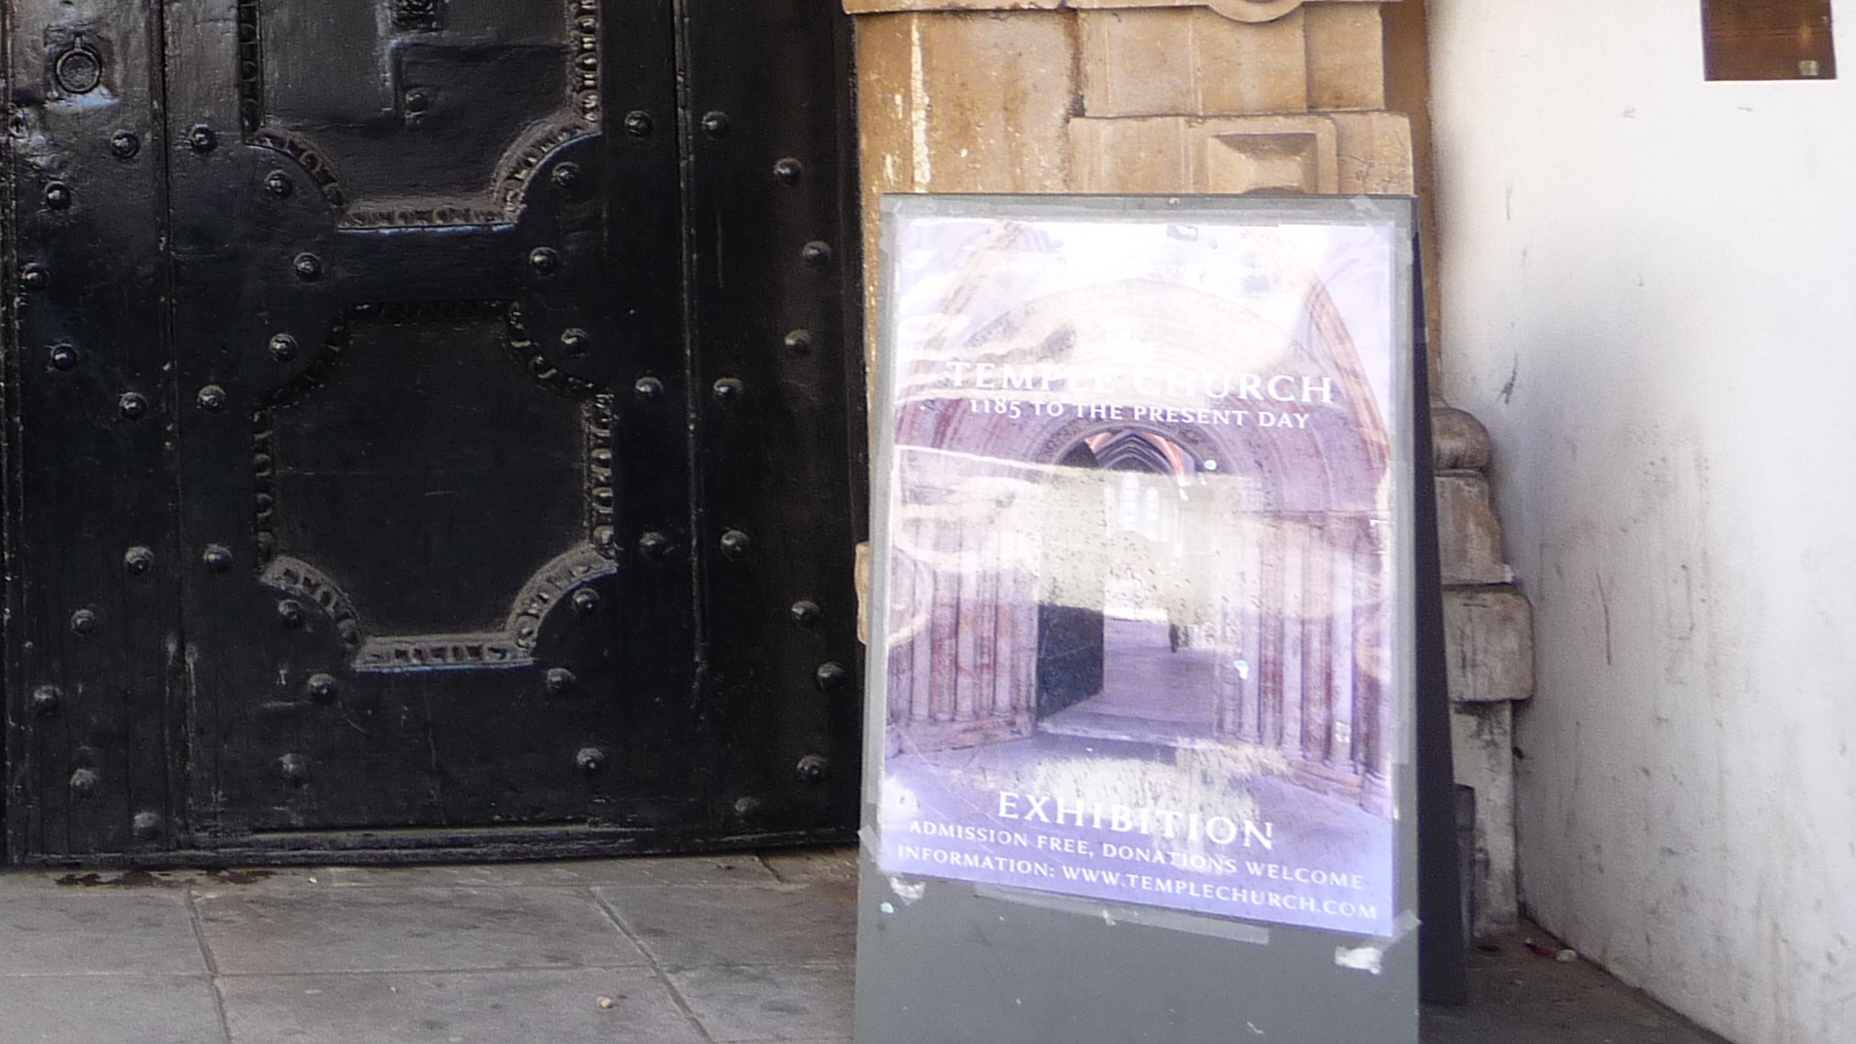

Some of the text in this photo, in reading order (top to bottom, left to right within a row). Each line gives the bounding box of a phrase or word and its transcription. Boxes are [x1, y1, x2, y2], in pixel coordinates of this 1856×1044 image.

[945, 361, 1333, 403] TEMPLE CHURCH
[971, 397, 1309, 429] 1185 TO THE PRESENT DAY
[998, 790, 1274, 850] EXHIBITION
[897, 845, 1377, 920] INFORMATION: WWW.TEMPLECHURCH.COM
[909, 820, 1363, 890] ADMISSION FREE, DONATIONS WELCOME
